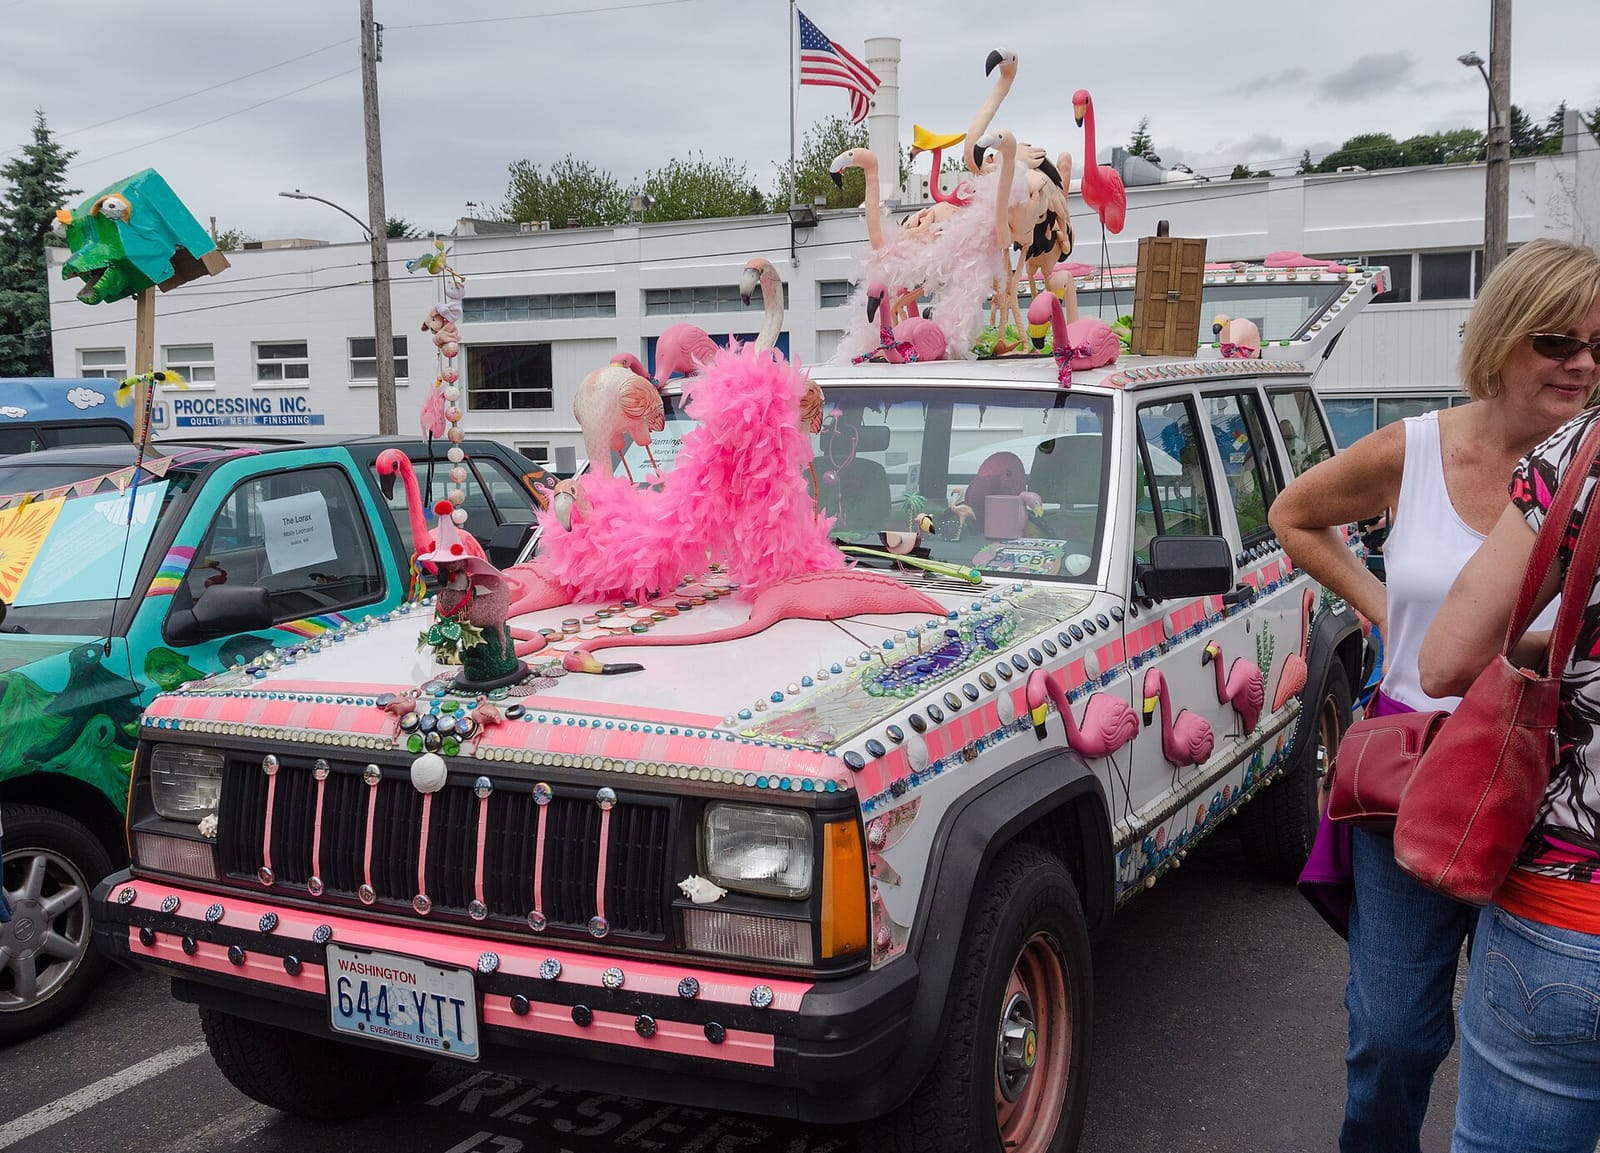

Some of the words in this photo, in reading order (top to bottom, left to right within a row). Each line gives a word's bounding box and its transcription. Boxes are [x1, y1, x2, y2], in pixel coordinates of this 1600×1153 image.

[174, 397, 271, 415] PROCESSING
[279, 396, 312, 414] INC.
[190, 417, 225, 426] QUALITY
[230, 417, 258, 425] METAL
[263, 415, 310, 425] FINISHING
[282, 517, 294, 526] The
[295, 514, 312, 524] Lorax
[338, 959, 417, 985] WASHINGTON
[336, 975, 466, 1042] 644-YTT
[370, 1025, 413, 1041] EVERGREEN
[415, 1035, 439, 1047] STATE
